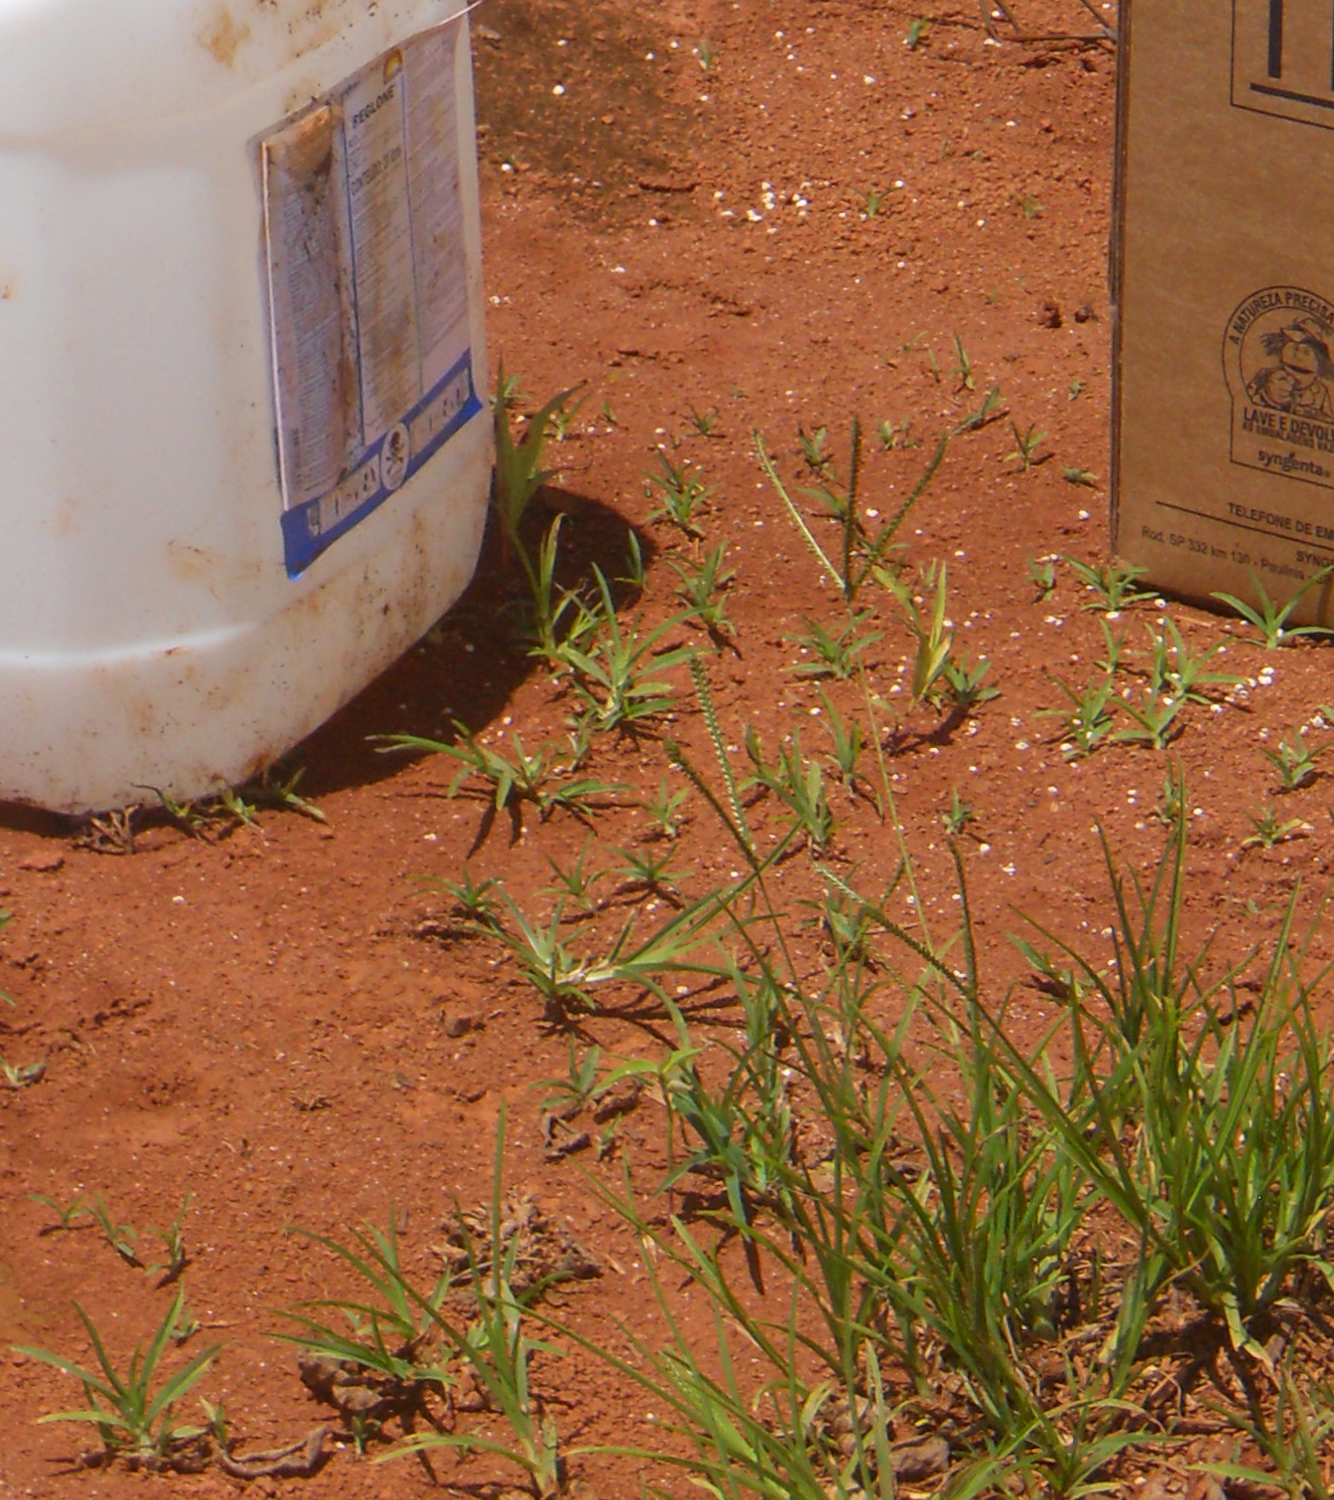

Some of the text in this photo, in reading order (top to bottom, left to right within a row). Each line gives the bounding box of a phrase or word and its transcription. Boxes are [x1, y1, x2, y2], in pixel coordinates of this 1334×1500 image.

[1233, 291, 1283, 336] NATUREZA
[1229, 334, 1240, 345] A
[1243, 406, 1275, 429] LAVE
[1279, 415, 1288, 430] E
[1258, 451, 1324, 478] syngenta
[1228, 502, 1292, 531] TELEFONE
[1295, 520, 1312, 535] DE
[1141, 525, 1165, 544] Rod.
[1169, 532, 1186, 547] SP
[1188, 538, 1208, 556] 332
[1211, 545, 1228, 561] km
